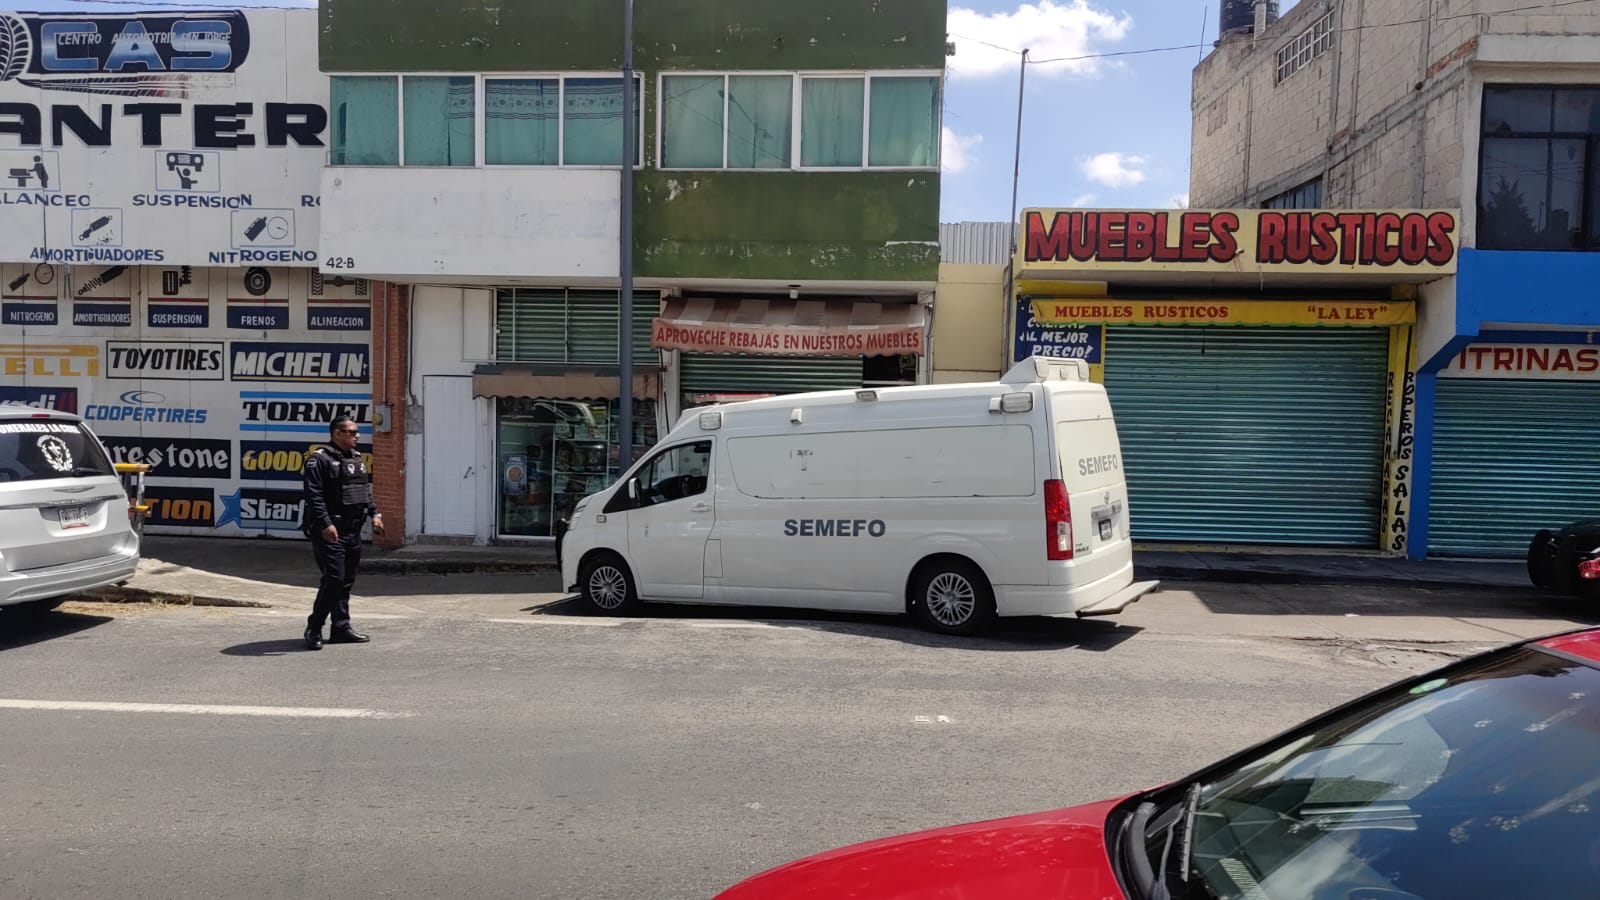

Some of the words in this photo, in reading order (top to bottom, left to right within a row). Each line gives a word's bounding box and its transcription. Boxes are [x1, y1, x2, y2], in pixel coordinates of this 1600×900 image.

[41, 20, 233, 71] CAS
[57, 32, 101, 46] CENTRO
[0, 102, 327, 148] ANTER
[0, 192, 91, 207] LANCEO
[132, 194, 252, 209] SUSPENSION
[1024, 211, 1240, 263] MUEBLES
[1255, 211, 1455, 266] RUSTICOS
[30, 247, 165, 262] AMORTIGUADORES
[208, 250, 317, 263] NITROGENO
[326, 257, 355, 270] 42-B
[10, 311, 55, 321] NITROGENO
[74, 312, 131, 323] AMORTIGUADORES
[241, 315, 276, 326] FRENOS
[1055, 306, 1133, 318] MUEBLES
[1143, 306, 1229, 319] RUSTICOS
[310, 316, 364, 327] ALINEACION
[656, 327, 726, 346] APROVECHE
[729, 332, 780, 349] REBAJAS
[783, 334, 800, 350] EN
[801, 334, 863, 350] NUESTROS
[866, 331, 920, 349] MUEBLES
[1019, 331, 1037, 342] AL
[1041, 331, 1089, 343] MEJOR
[110, 348, 221, 371] TOYOTIRES
[1031, 344, 1094, 358] PRECIO!
[1442, 347, 1600, 372] ITRINAS
[233, 351, 363, 378] MICHELIN
[85, 404, 208, 424] COOPERTIRES
[242, 402, 373, 424] TORNEL
[1401, 371, 1415, 460] ROPEROS
[1078, 454, 1118, 476] SEMEFO
[1391, 465, 1409, 550] SALAS
[784, 519, 886, 538] SEMEFO
